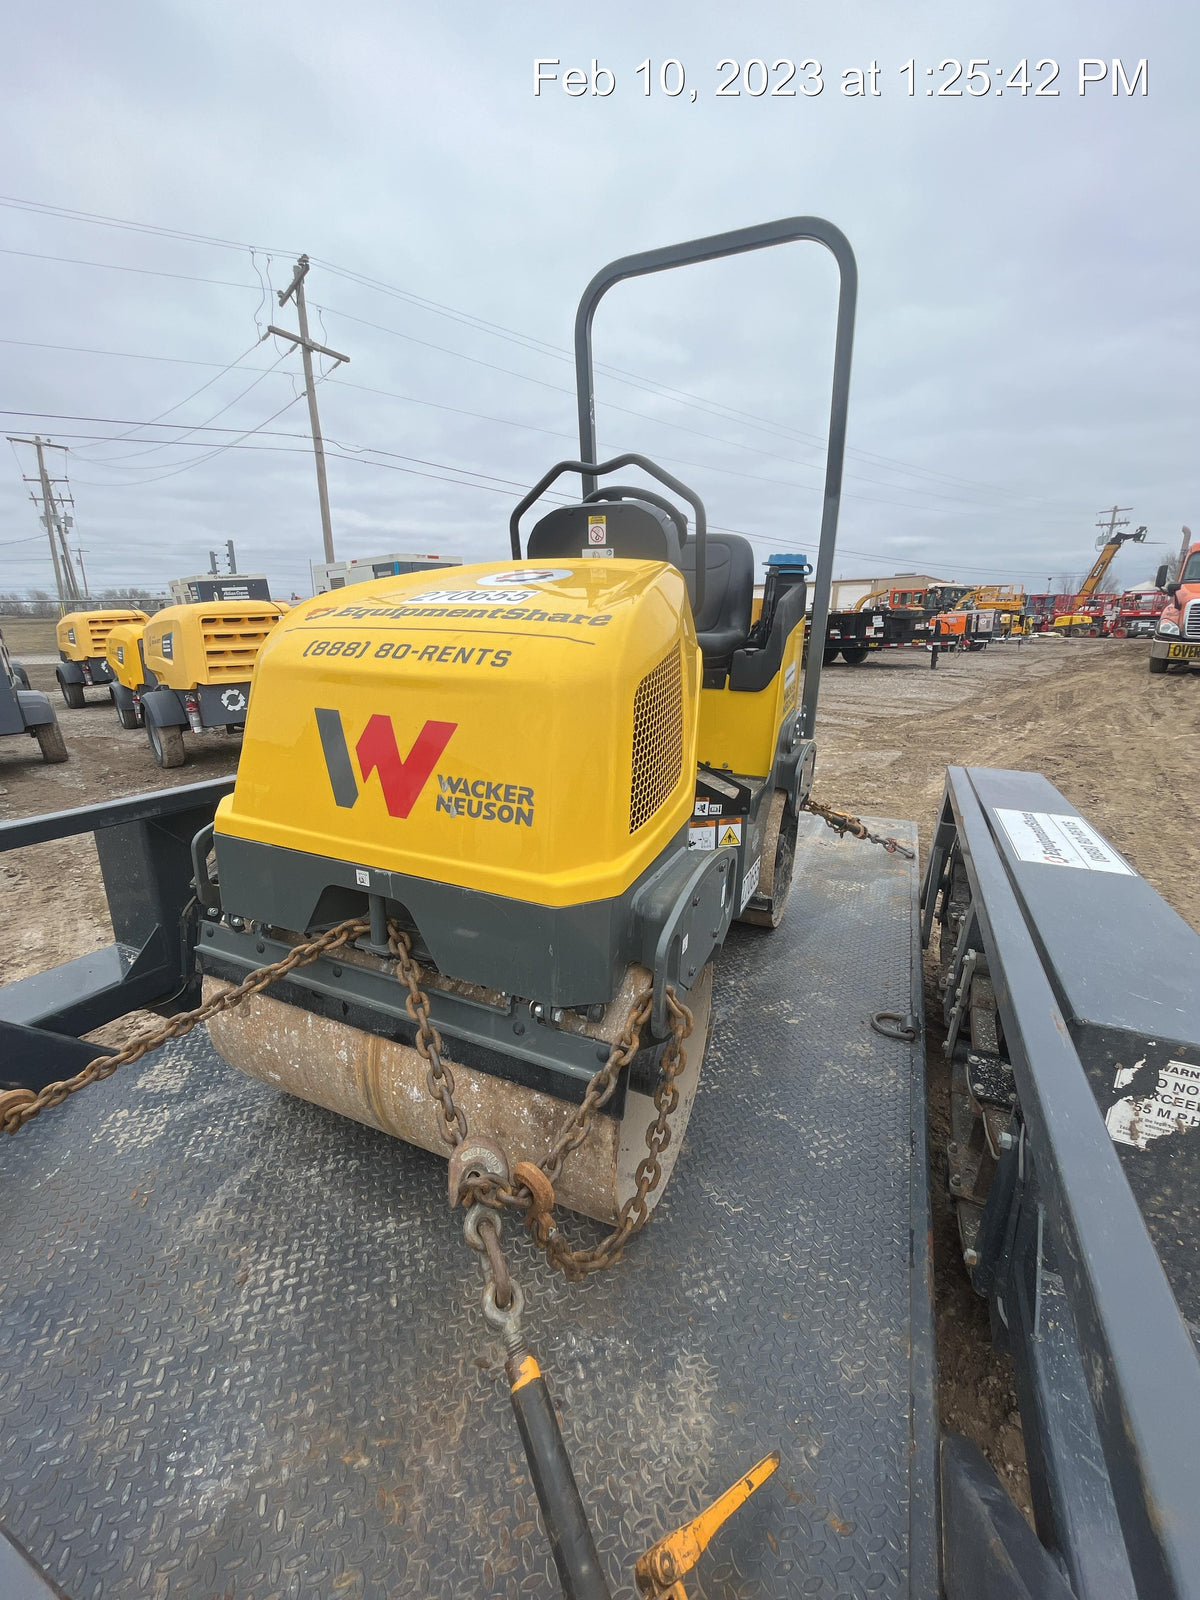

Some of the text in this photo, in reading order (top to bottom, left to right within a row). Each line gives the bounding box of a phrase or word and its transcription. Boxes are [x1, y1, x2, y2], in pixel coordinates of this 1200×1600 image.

[408, 590, 538, 602] 270655
[332, 606, 614, 627] EquipmentShare
[303, 639, 513, 668] (888) 80-RENTS
[437, 774, 535, 807] WACKER
[435, 794, 535, 828] NEUSON
[1151, 1091, 1200, 1111] XCEE
